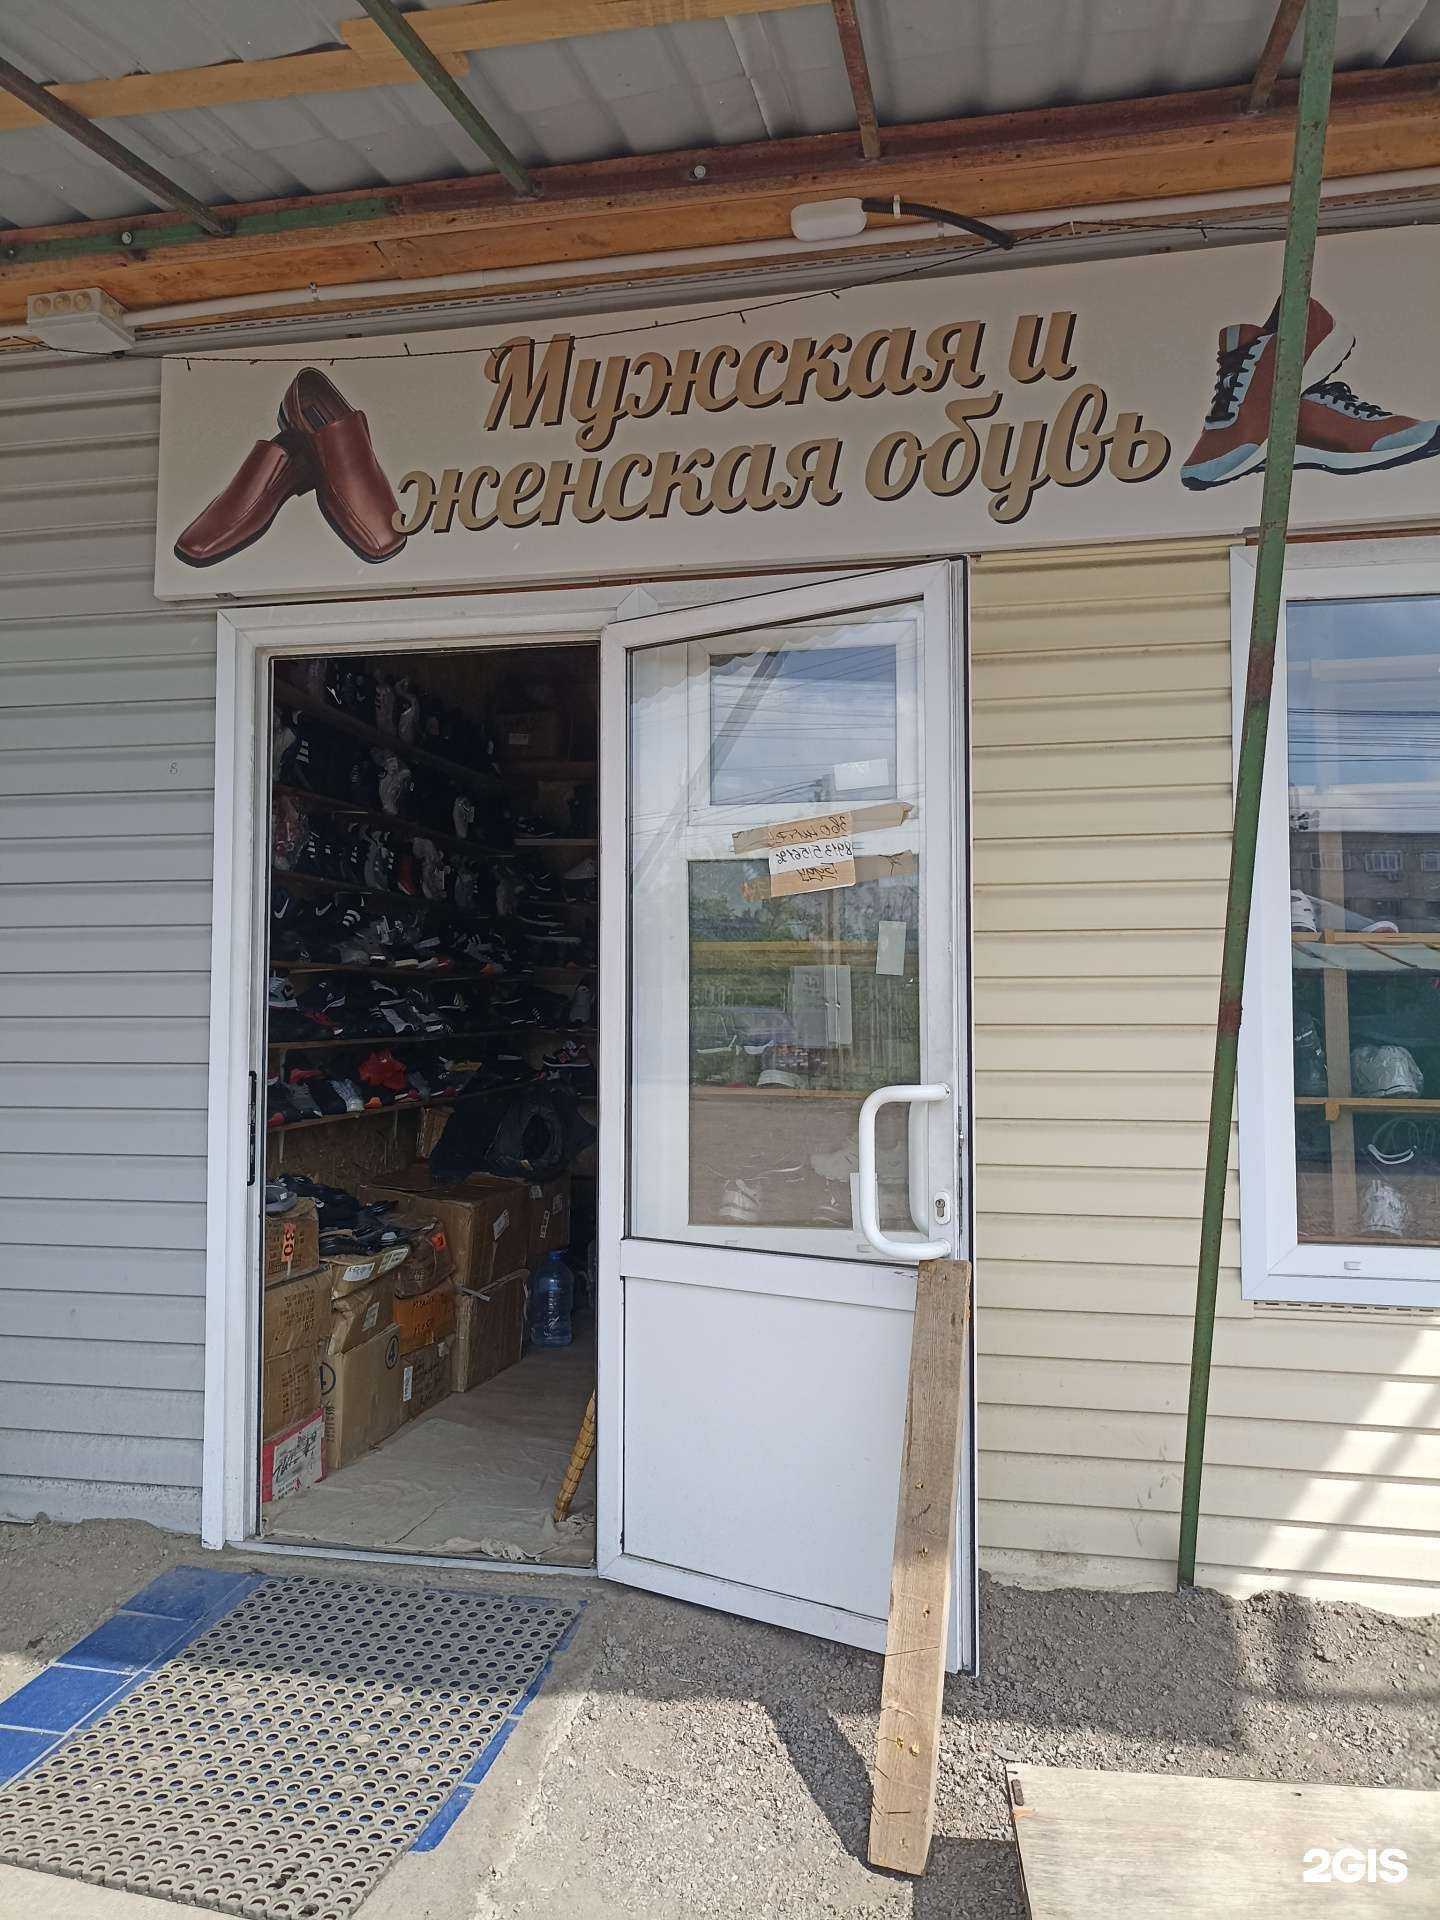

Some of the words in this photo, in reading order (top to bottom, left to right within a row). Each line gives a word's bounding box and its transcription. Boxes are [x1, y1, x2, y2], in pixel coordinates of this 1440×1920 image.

[484, 320, 985, 452] Мужская
[1008, 311, 1077, 384] и
[392, 437, 843, 536] женская
[865, 383, 1171, 524] обувь
